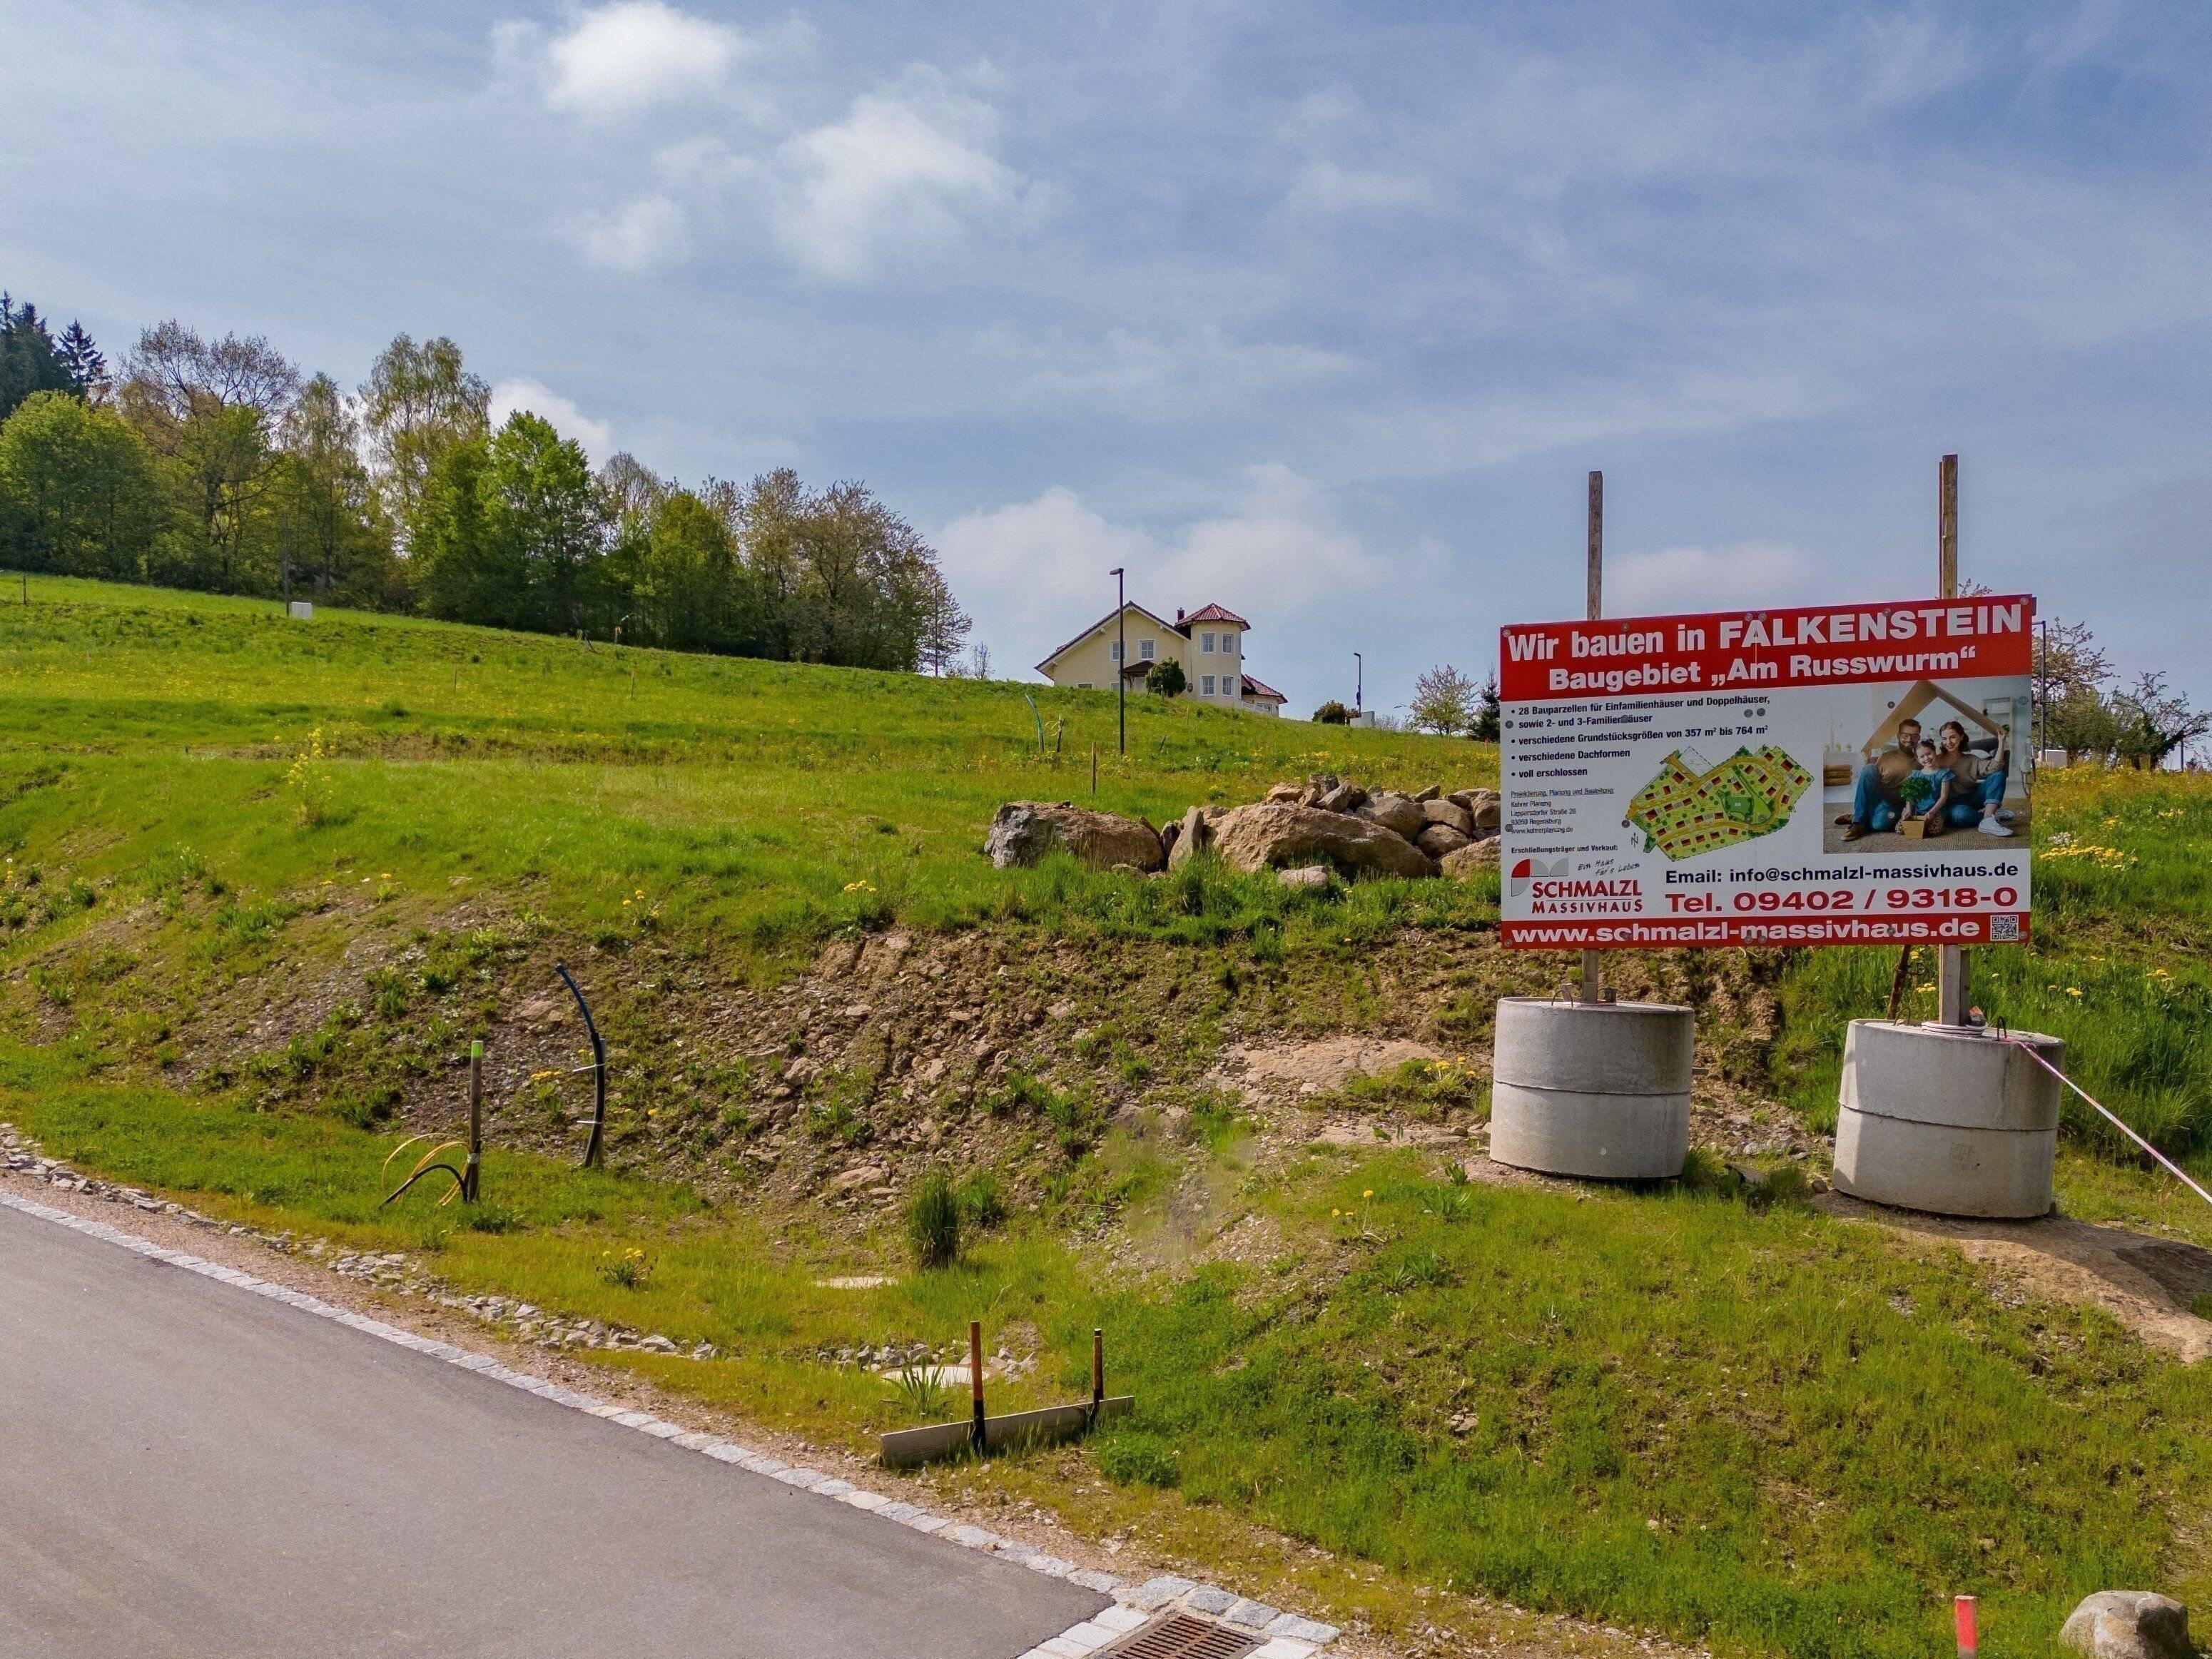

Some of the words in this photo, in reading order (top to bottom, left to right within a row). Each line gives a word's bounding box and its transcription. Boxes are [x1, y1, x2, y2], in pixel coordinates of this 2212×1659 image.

[1508, 633, 1559, 661] Wir
[1571, 631, 1663, 658] bauen
[1678, 624, 1705, 651] in
[1720, 604, 2021, 649] FALKENSTEIN
[1549, 661, 1701, 692] Baugebiet
[1518, 707, 1529, 716] 28
[1532, 704, 1588, 716] Bauparzellen
[1590, 703, 1603, 711] für
[1605, 699, 1684, 711] Einfamilienhäuser
[1687, 698, 1703, 706] und
[1706, 696, 1770, 706] Doppelhäuser,
[1518, 720, 1544, 729] sowie
[1558, 718, 1575, 726] und
[1577, 715, 1653, 726] 3-Familienäuser
[1518, 735, 1575, 745] verschiedene
[1578, 731, 1663, 743] Grundstücksgrößen
[1685, 729, 1702, 737] 357
[1720, 727, 1733, 736] bis
[1735, 726, 1752, 735] 764
[1518, 751, 1575, 761] verschiedene
[1578, 750, 1630, 759] Dachformen
[1518, 769, 1533, 778] voll
[1536, 768, 1588, 778] erschlossen
[1511, 845, 1575, 854] Erschließungsträger
[1665, 868, 1722, 883] Email:
[1730, 862, 2019, 883] info@schmalzl-massivhaus.de
[1532, 879, 1643, 898] SCHMALZL
[1531, 899, 1643, 914] MASSIVHAUS
[1665, 892, 1723, 913] Tel.
[1733, 890, 1854, 912] 09402
[1864, 888, 1877, 910] /
[1886, 887, 2018, 909] 9318-0
[1511, 918, 1980, 943] www.schmalzl-massivhaus.de
